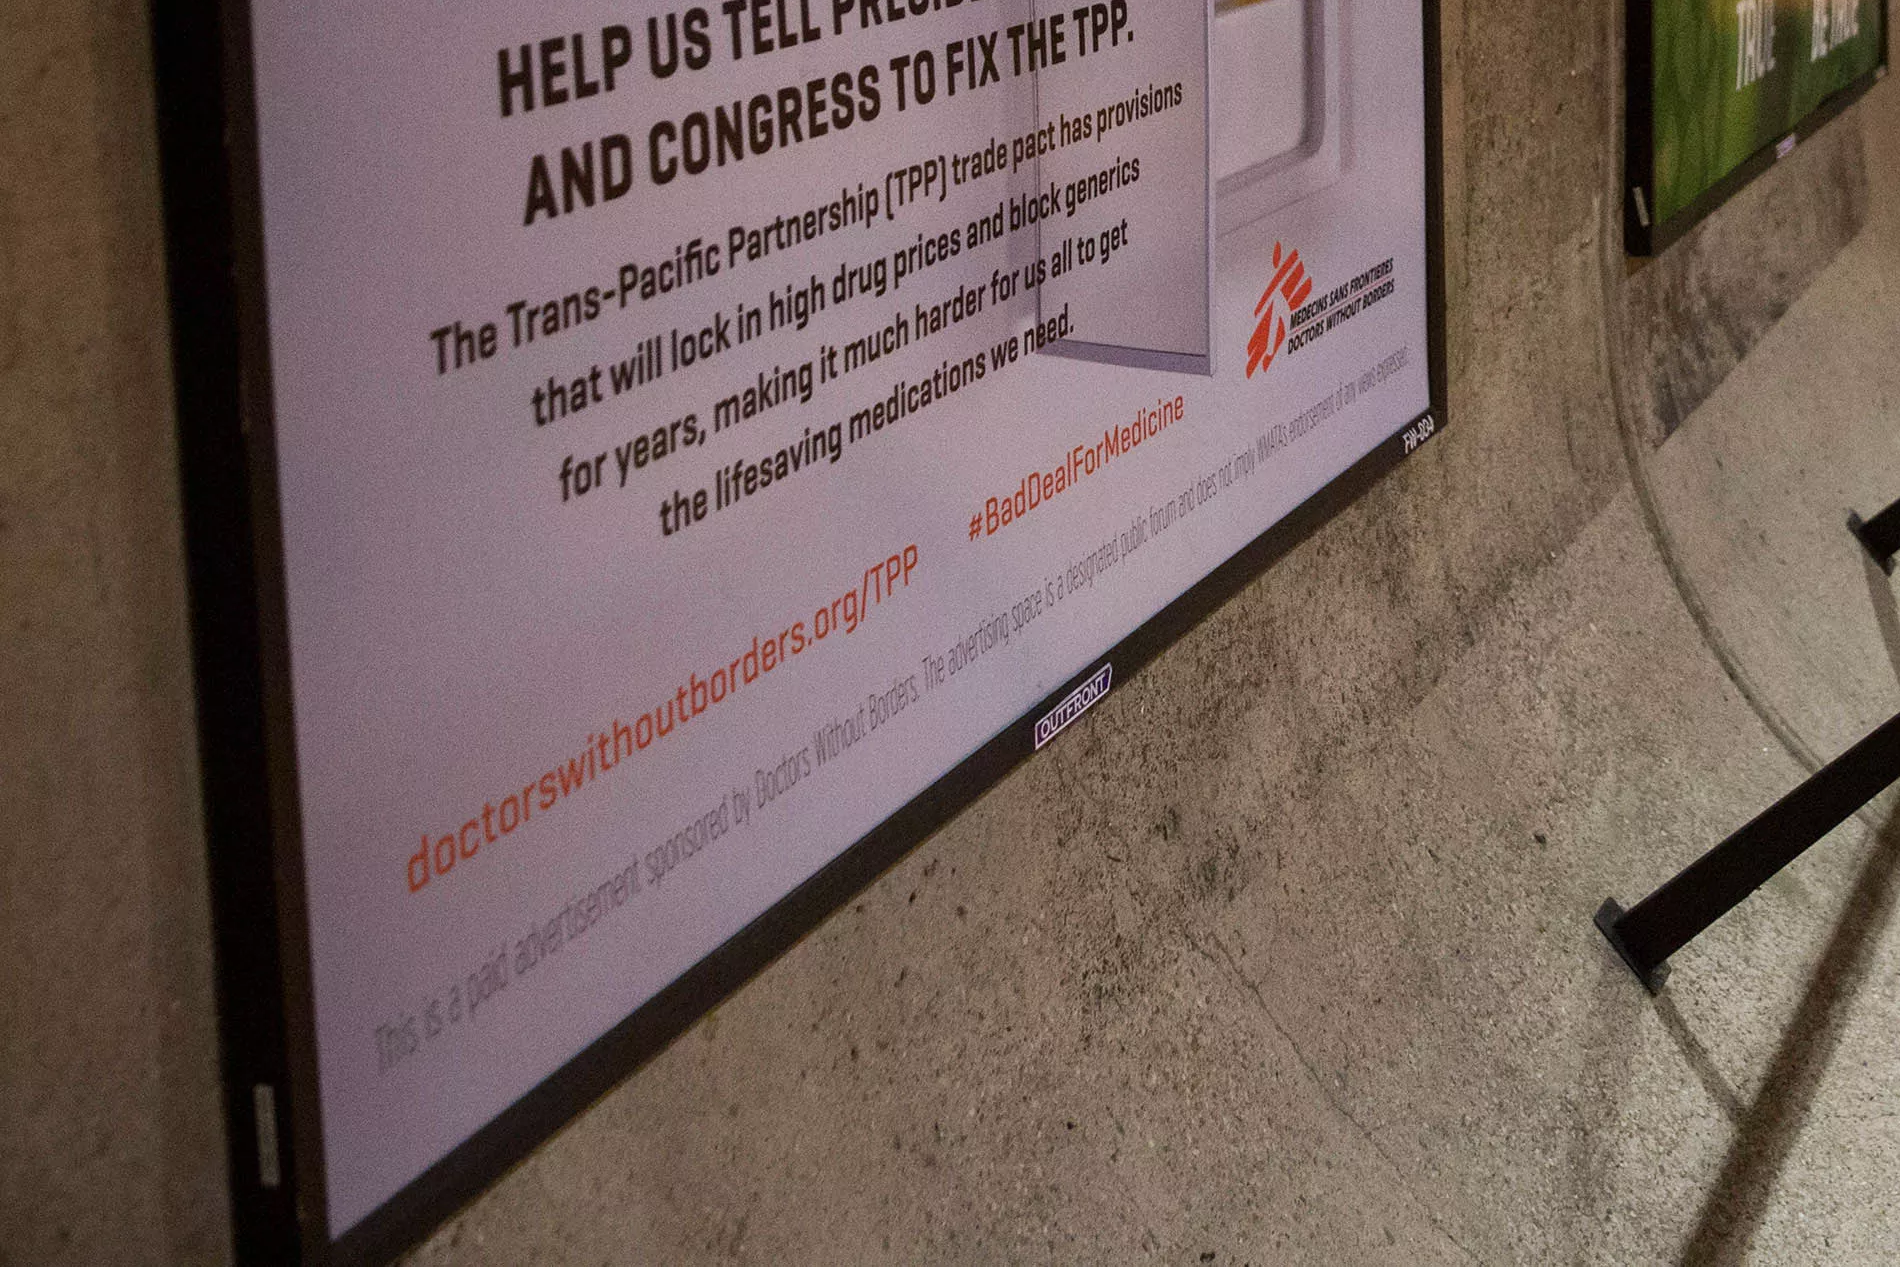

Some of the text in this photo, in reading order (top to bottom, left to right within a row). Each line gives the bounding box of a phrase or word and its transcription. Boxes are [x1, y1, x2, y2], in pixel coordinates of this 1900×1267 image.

[497, 24, 632, 118] HELP
[647, 6, 711, 79] US
[523, 133, 632, 226] AND
[648, 64, 881, 185] CONGRESS
[889, 49, 935, 111] TO
[945, 30, 999, 96] FIX
[1005, 12, 1066, 77] THE
[429, 320, 497, 375] The
[505, 237, 720, 347] Trans-Pacific
[728, 182, 879, 269] Partnership
[951, 137, 1007, 185] trade
[1011, 120, 1056, 174] pact
[1059, 112, 1092, 147] has
[1096, 81, 1182, 143] provisions
[530, 155, 1139, 427] that will lock in high drug prices and block generics
[1287, 277, 1394, 355] DOCTORS WITHOUT BORDERS
[1289, 257, 1393, 330] MEDECINS SANS FRONTIERES
[558, 217, 1127, 502] for years, making it much harder for us all to get
[658, 301, 1074, 537] the lifesaving medications we need.
[968, 395, 1183, 541] #BadDealForMedicine
[406, 543, 918, 894] doctorswithoutborders.org/TPP
[1040, 672, 1106, 739] OUTFRONT
